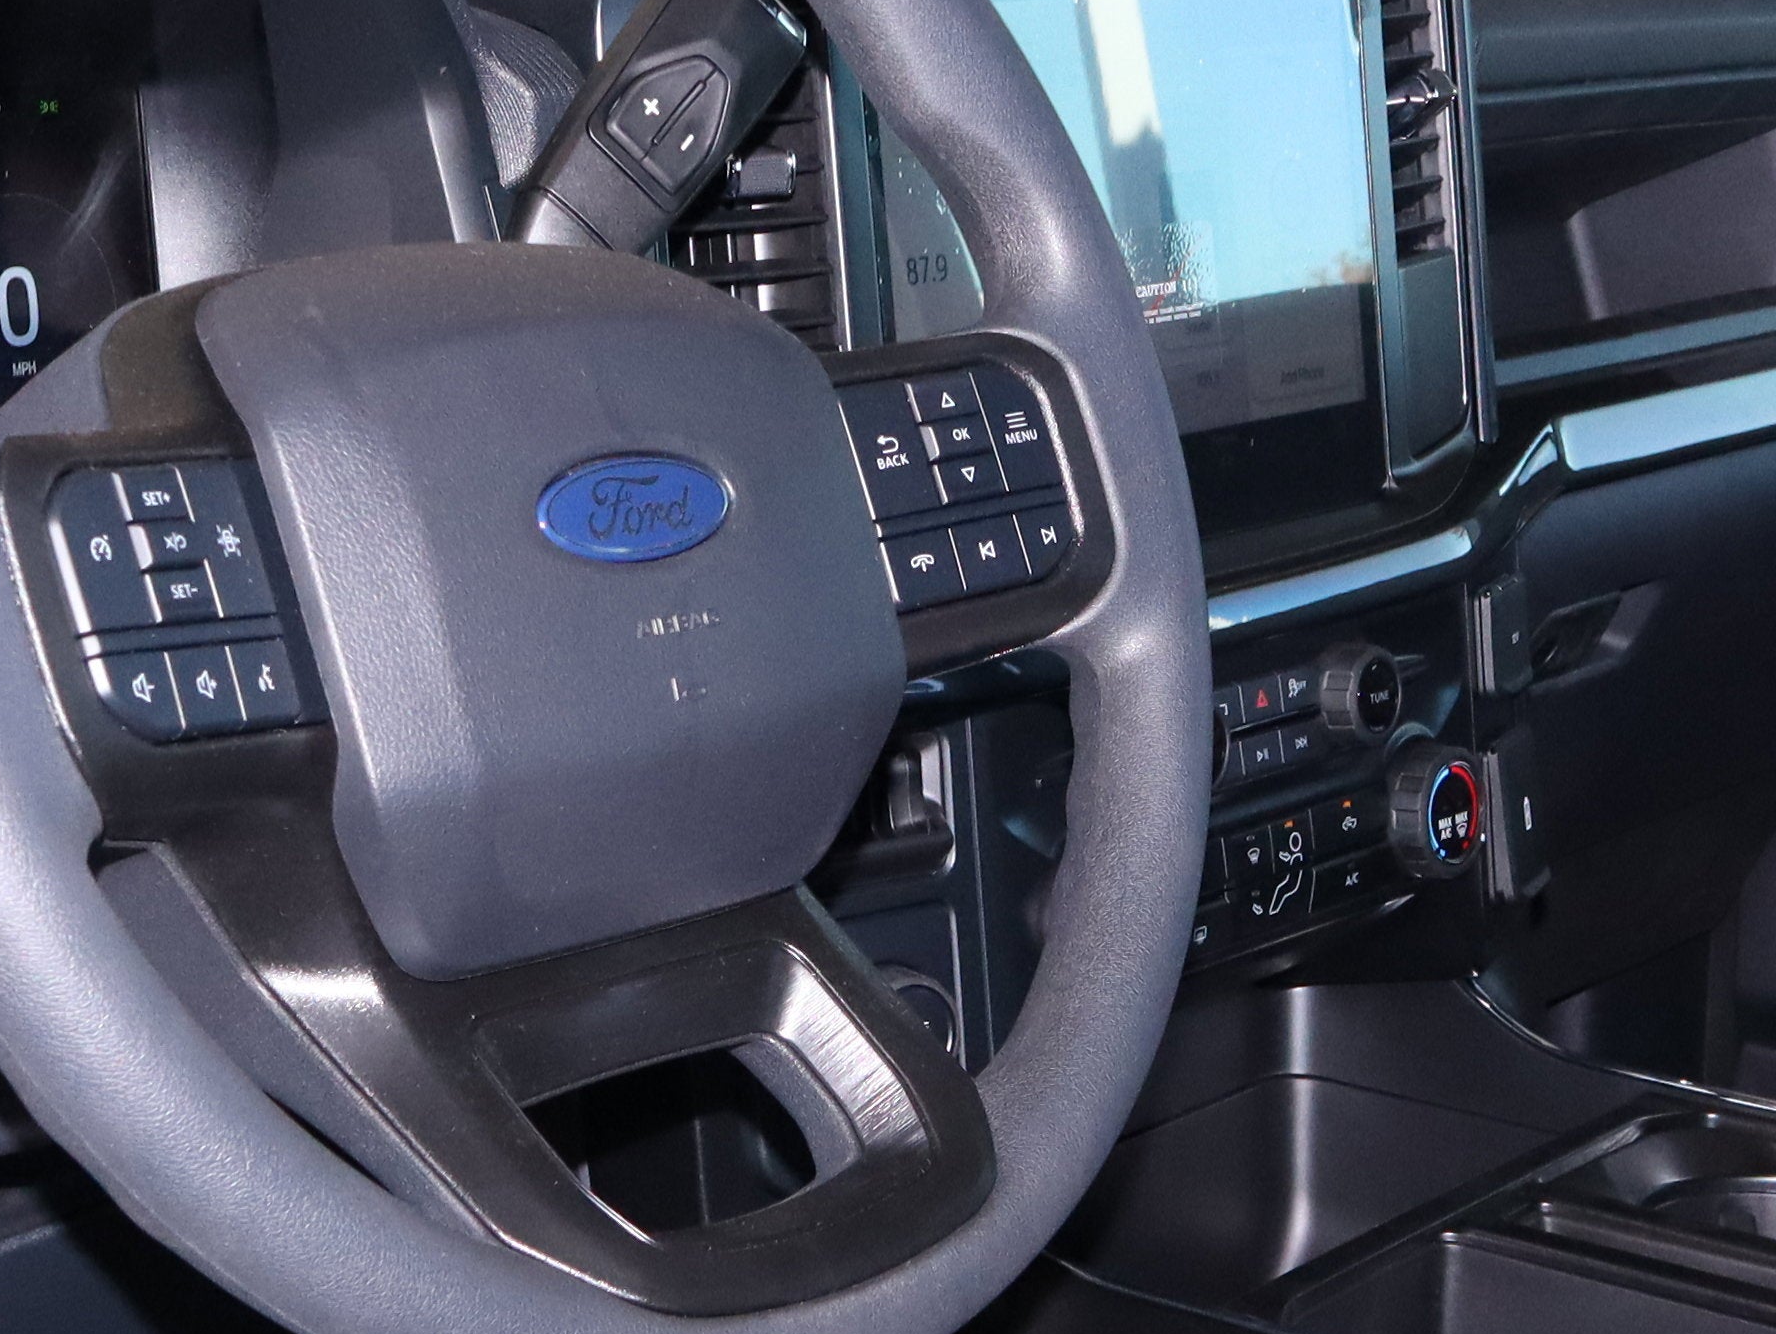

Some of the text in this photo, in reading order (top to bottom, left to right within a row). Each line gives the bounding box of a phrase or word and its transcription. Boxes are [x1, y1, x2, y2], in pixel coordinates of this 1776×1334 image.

[906, 253, 947, 285] 87.9
[12, 360, 37, 377] MPH
[952, 427, 971, 442] OK
[1004, 428, 1038, 445] MENU
[876, 452, 910, 471] BACK
[588, 474, 695, 542] Ford
[1370, 688, 1390, 704] TUNE
